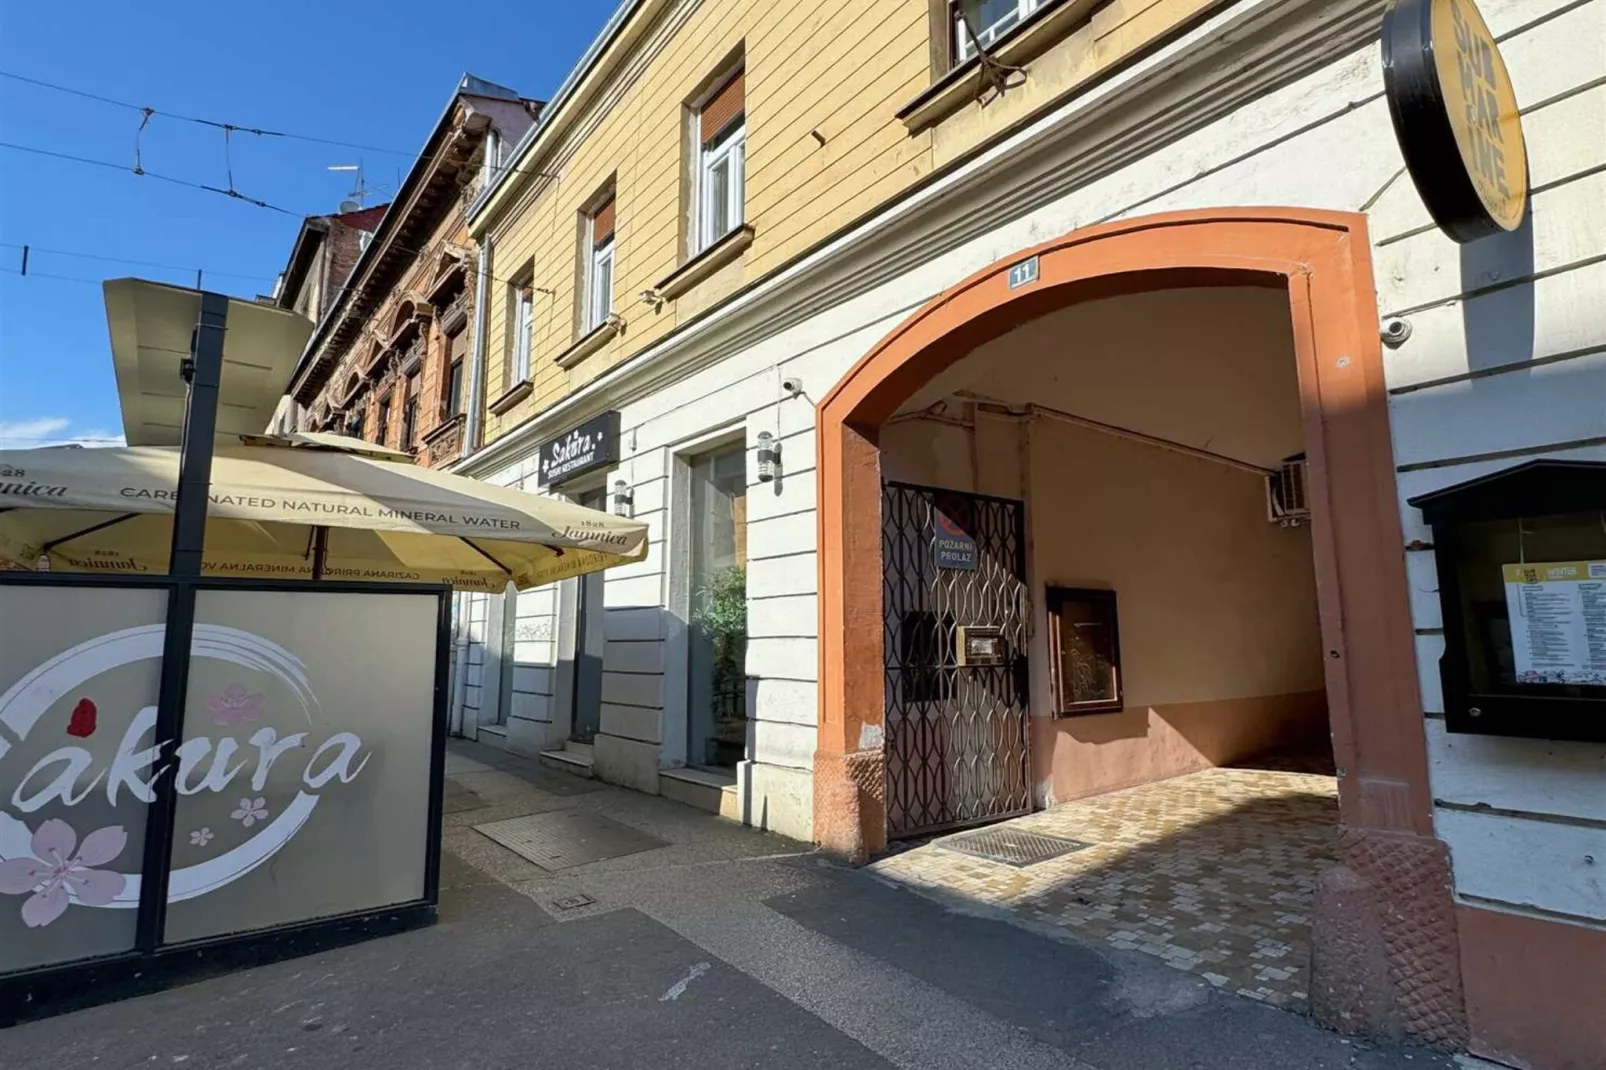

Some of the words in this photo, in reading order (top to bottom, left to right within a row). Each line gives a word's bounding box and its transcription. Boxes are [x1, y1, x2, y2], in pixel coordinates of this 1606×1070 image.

[1013, 263, 1030, 283] 11
[0, 480, 68, 497] nica
[120, 487, 276, 508] CARBNATED
[282, 500, 373, 517] NATURAL
[379, 508, 458, 524] MINERAL
[462, 515, 521, 530] WATER
[551, 525, 628, 546] Jamnica
[940, 551, 972, 562] PROLAZ
[0, 706, 373, 813] akura
